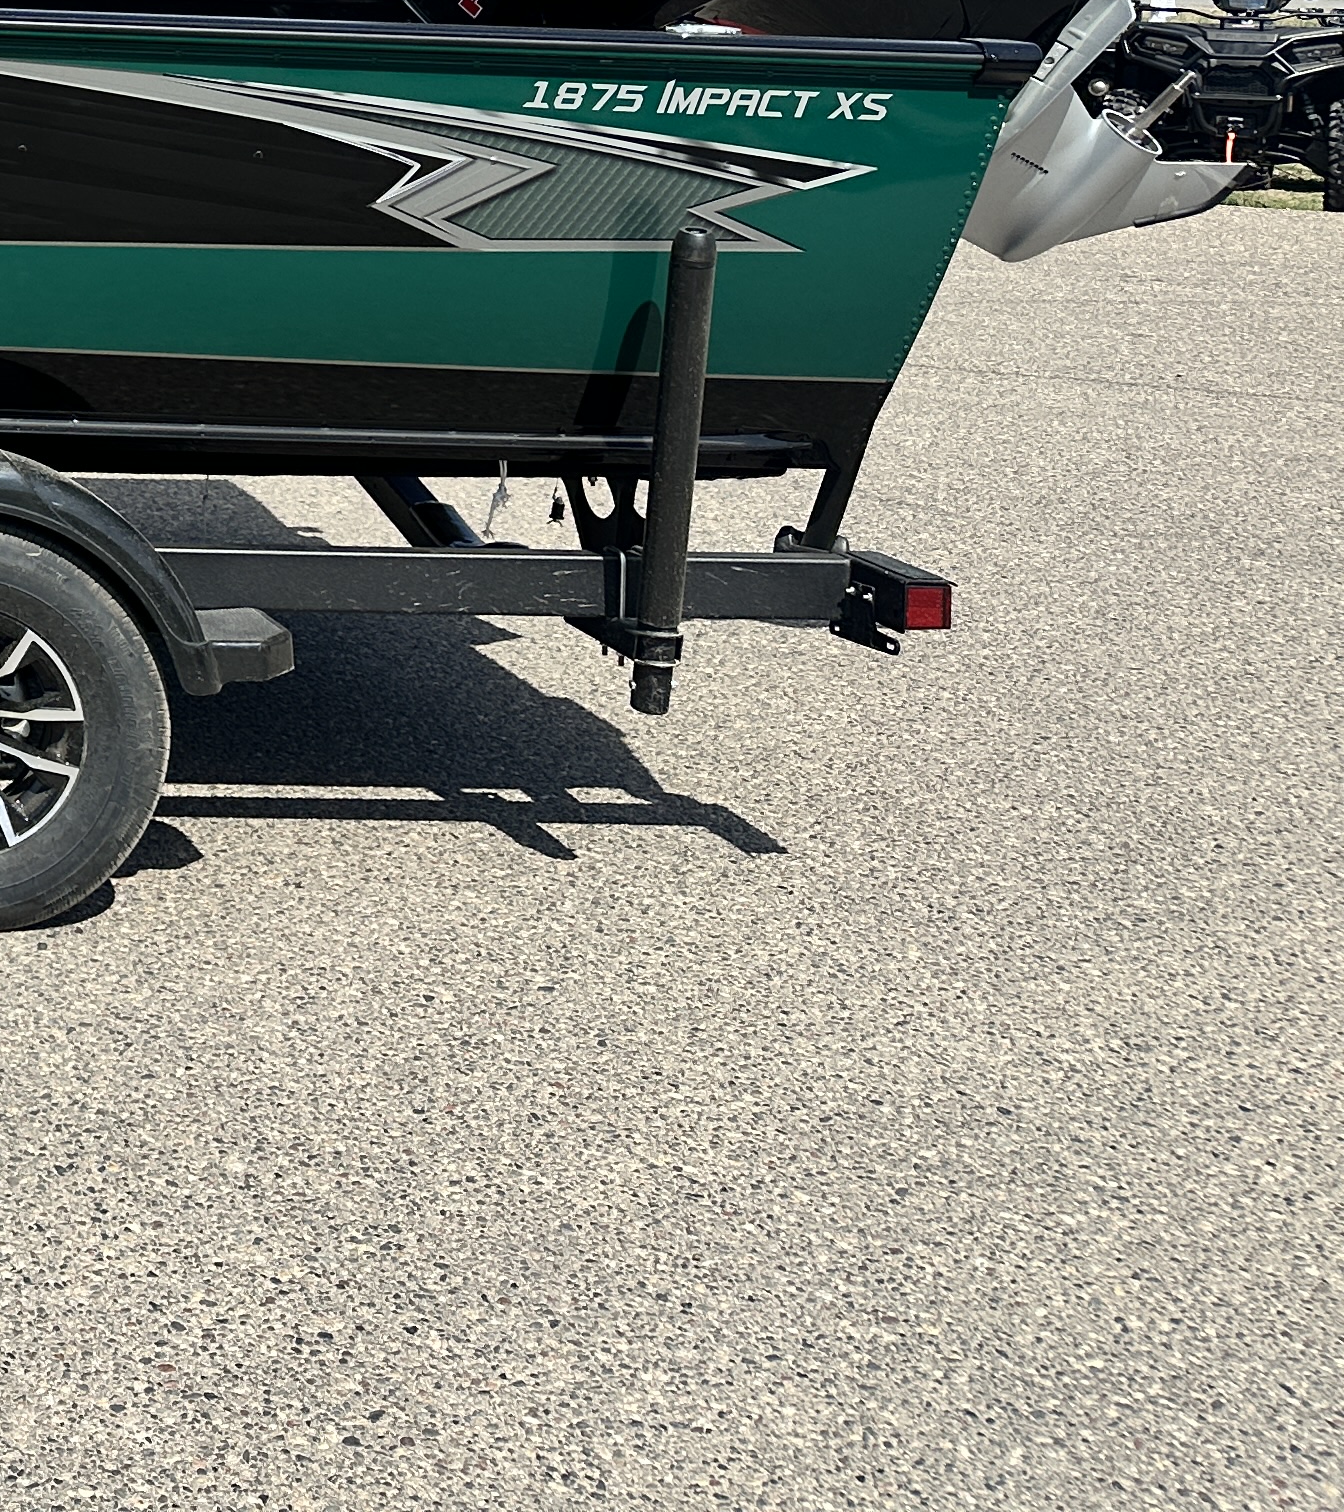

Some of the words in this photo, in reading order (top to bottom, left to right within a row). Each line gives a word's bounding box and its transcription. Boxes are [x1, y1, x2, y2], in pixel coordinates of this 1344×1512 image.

[522, 81, 648, 112] 1875
[656, 79, 820, 118] IMPACT
[827, 92, 893, 120] XS
